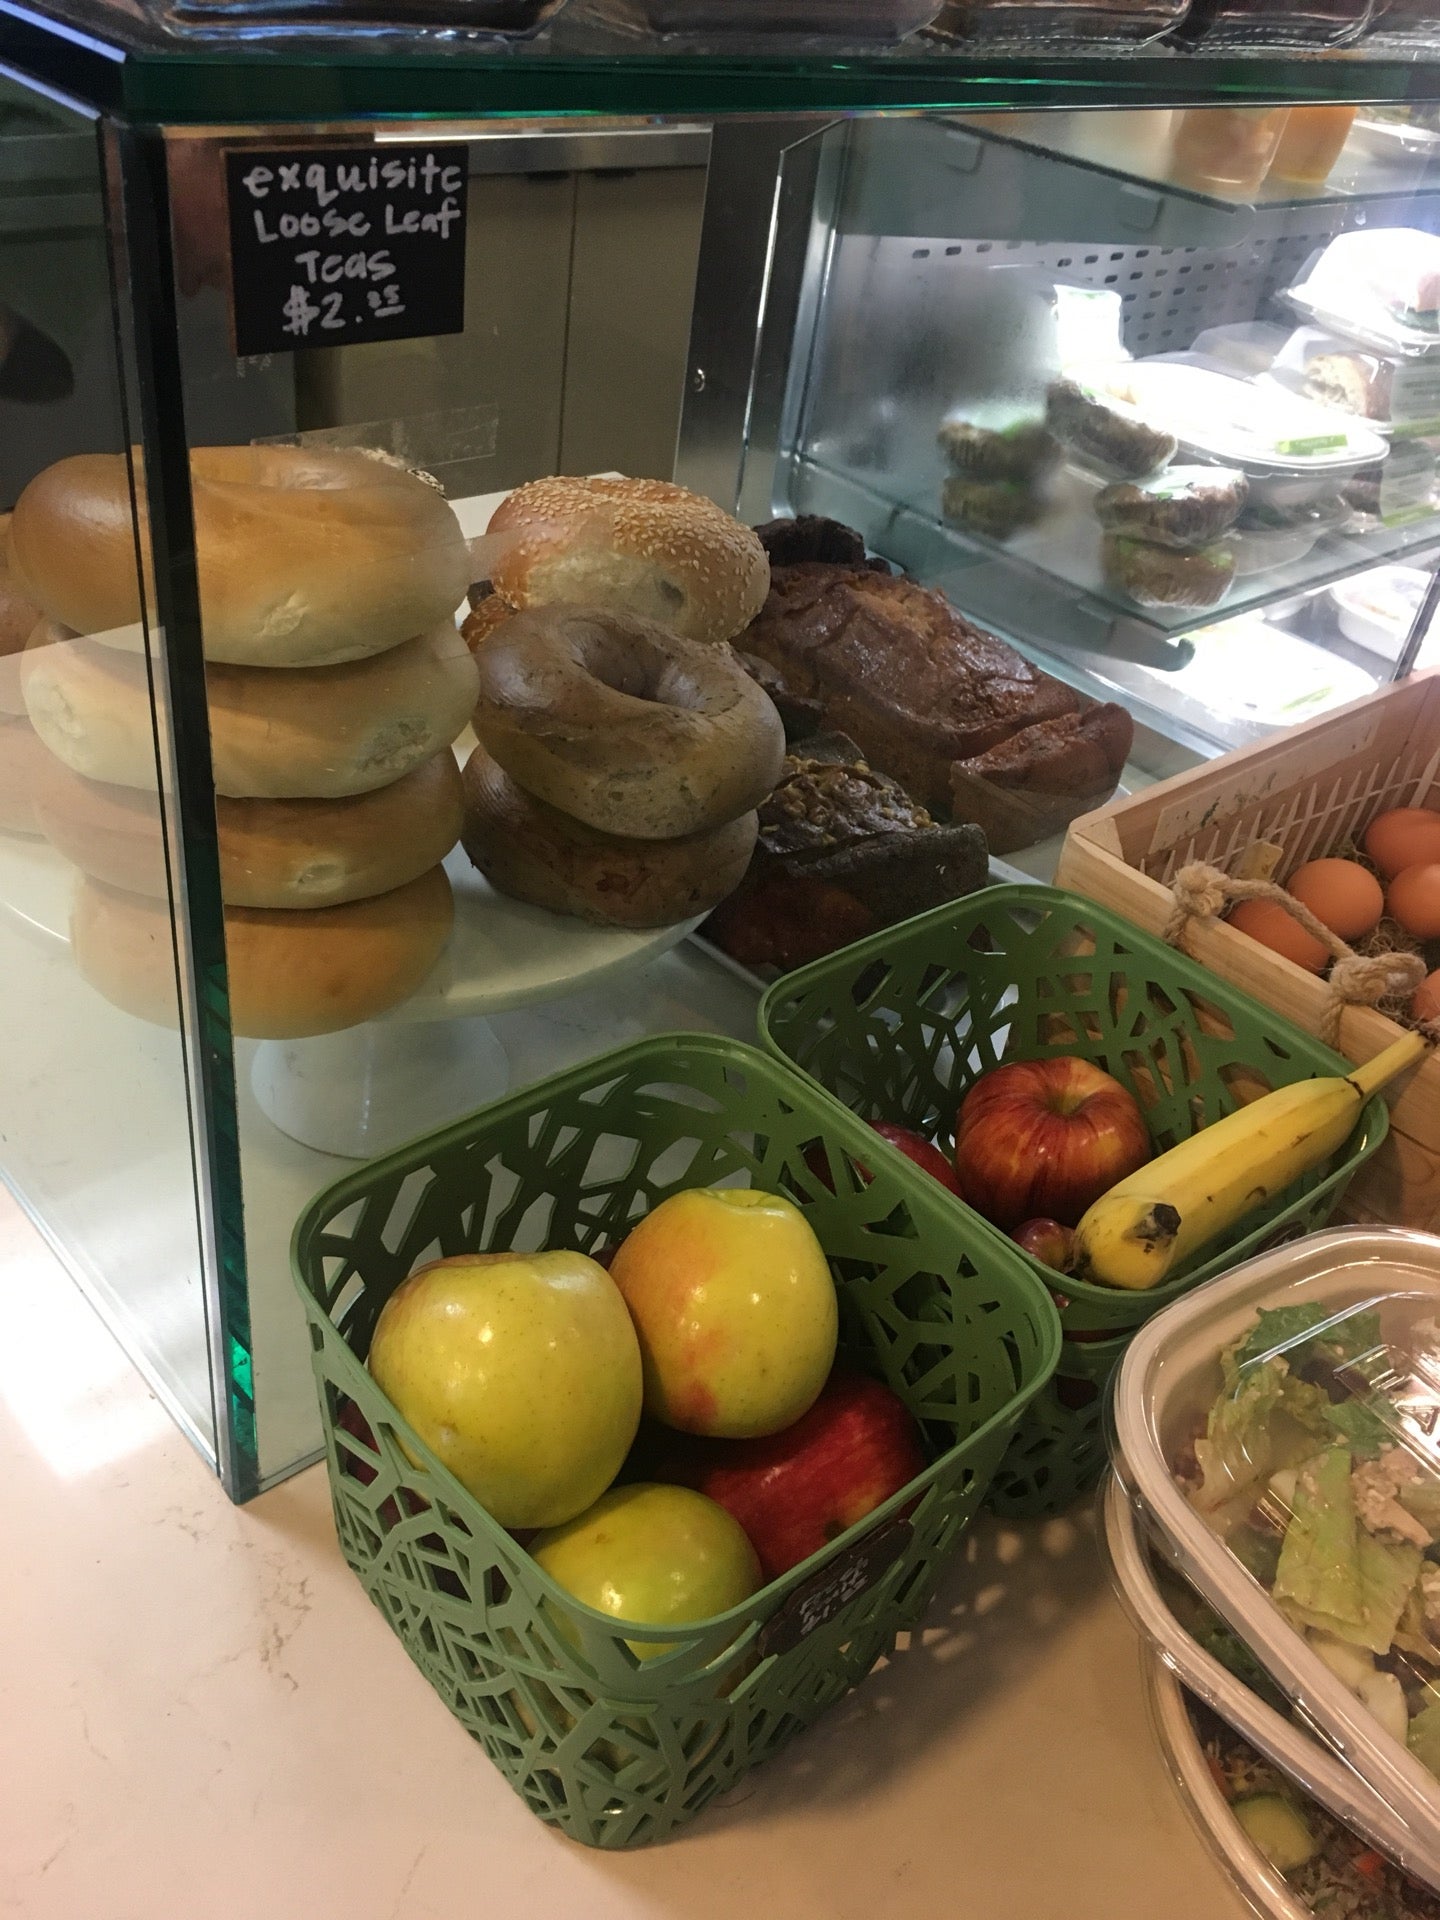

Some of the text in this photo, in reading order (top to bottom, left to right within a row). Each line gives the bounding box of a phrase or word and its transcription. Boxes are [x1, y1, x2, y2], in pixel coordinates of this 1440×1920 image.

[242, 154, 462, 206] exquisite
[253, 197, 461, 243] Loose Leaf
[294, 250, 396, 283] Teas
